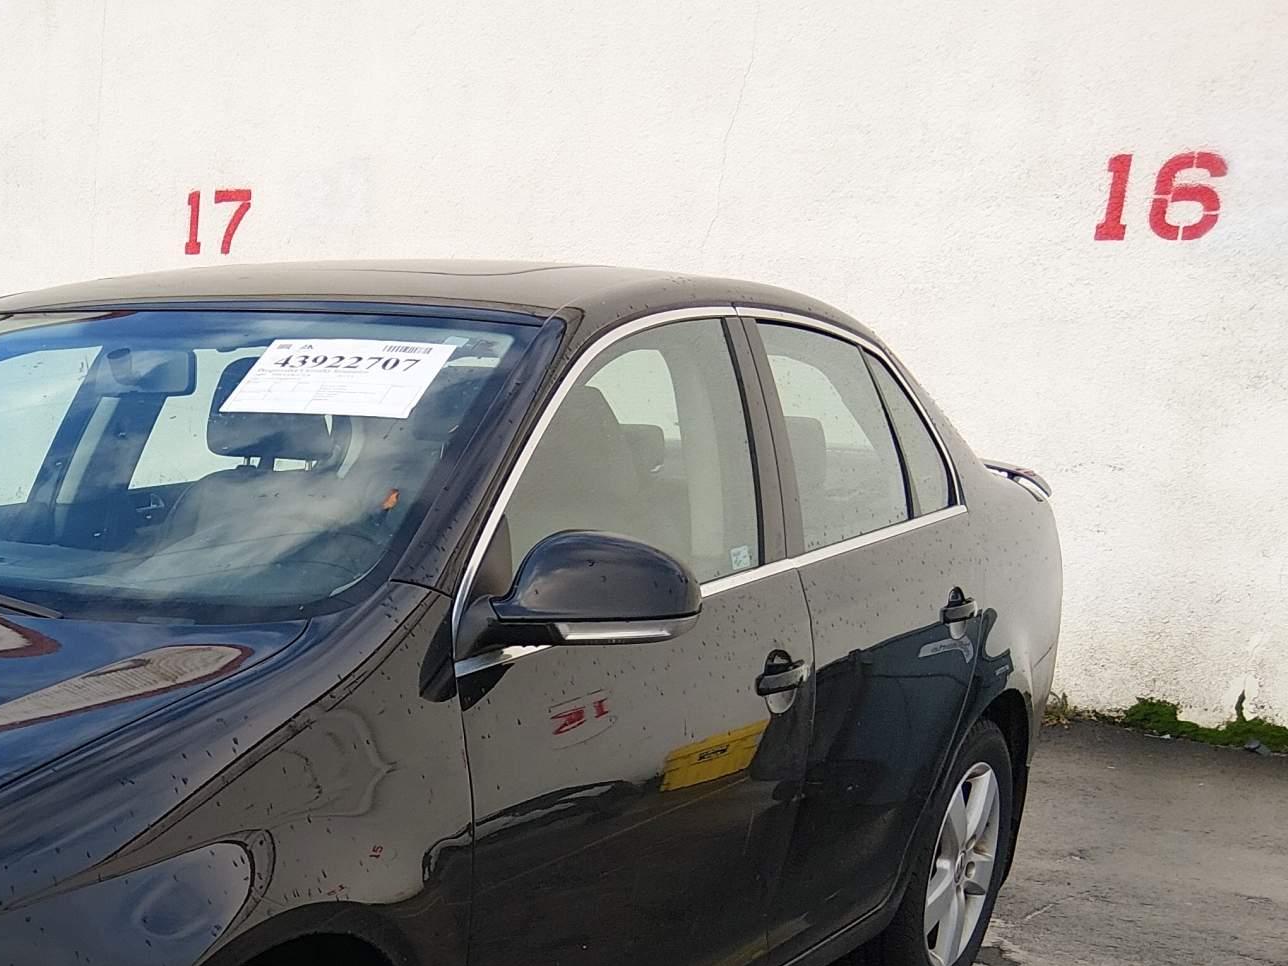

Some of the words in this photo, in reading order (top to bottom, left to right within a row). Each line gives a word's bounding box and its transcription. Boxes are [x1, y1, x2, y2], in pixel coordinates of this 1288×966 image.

[184, 189, 252, 255] 17
[1093, 151, 1228, 241] 16
[274, 354, 421, 372] 43922707
